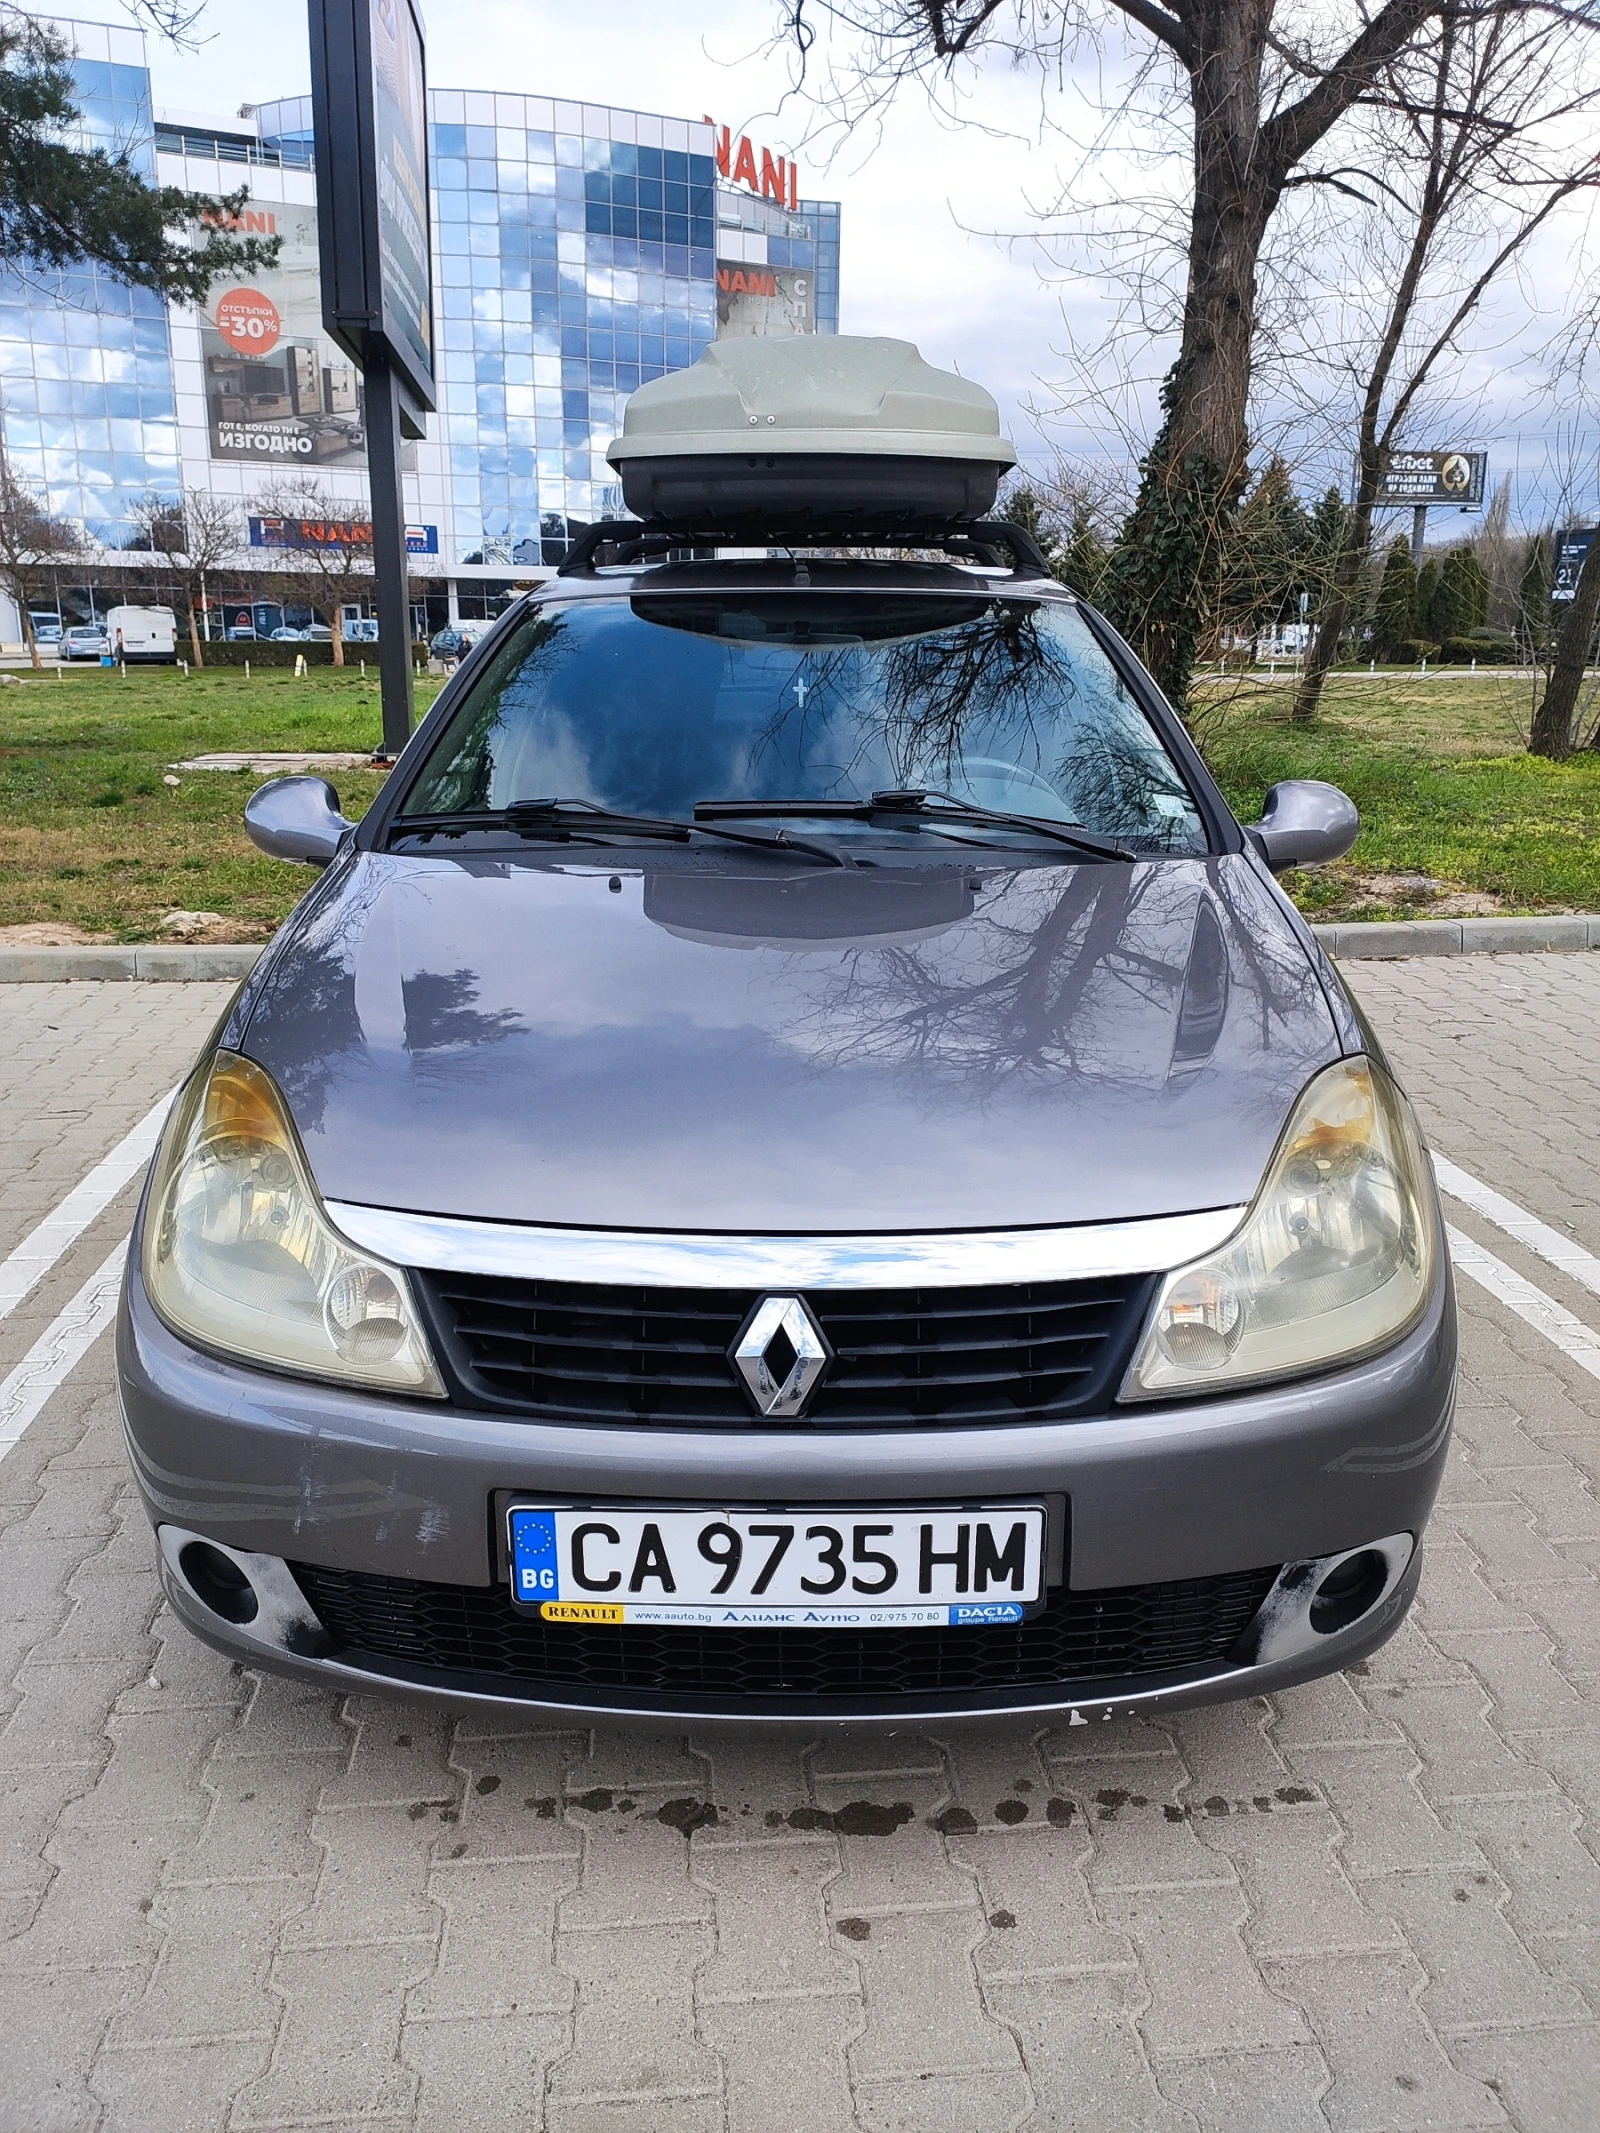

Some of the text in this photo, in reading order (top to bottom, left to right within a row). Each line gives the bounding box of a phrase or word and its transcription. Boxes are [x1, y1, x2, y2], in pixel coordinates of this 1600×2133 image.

[703, 114, 797, 211] NANI
[716, 268, 776, 297] NANI
[221, 304, 273, 316] ОТСТЪПКИ
[245, 424, 280, 433] КОГАТО
[282, 426, 293, 434] ТИ
[294, 427, 300, 435] Е
[219, 432, 313, 453] ИЗГОДНО
[570, 1522, 1028, 1596] CA 9735 HM
[522, 1568, 554, 1589] BG
[548, 1606, 619, 1619] RENAULT
[634, 1611, 712, 1622] www.aauto.bg
[869, 1611, 940, 1622] 02/975 70 80
[957, 1606, 1017, 1618] DACIA
[957, 1615, 1020, 1625] groupe Renault
